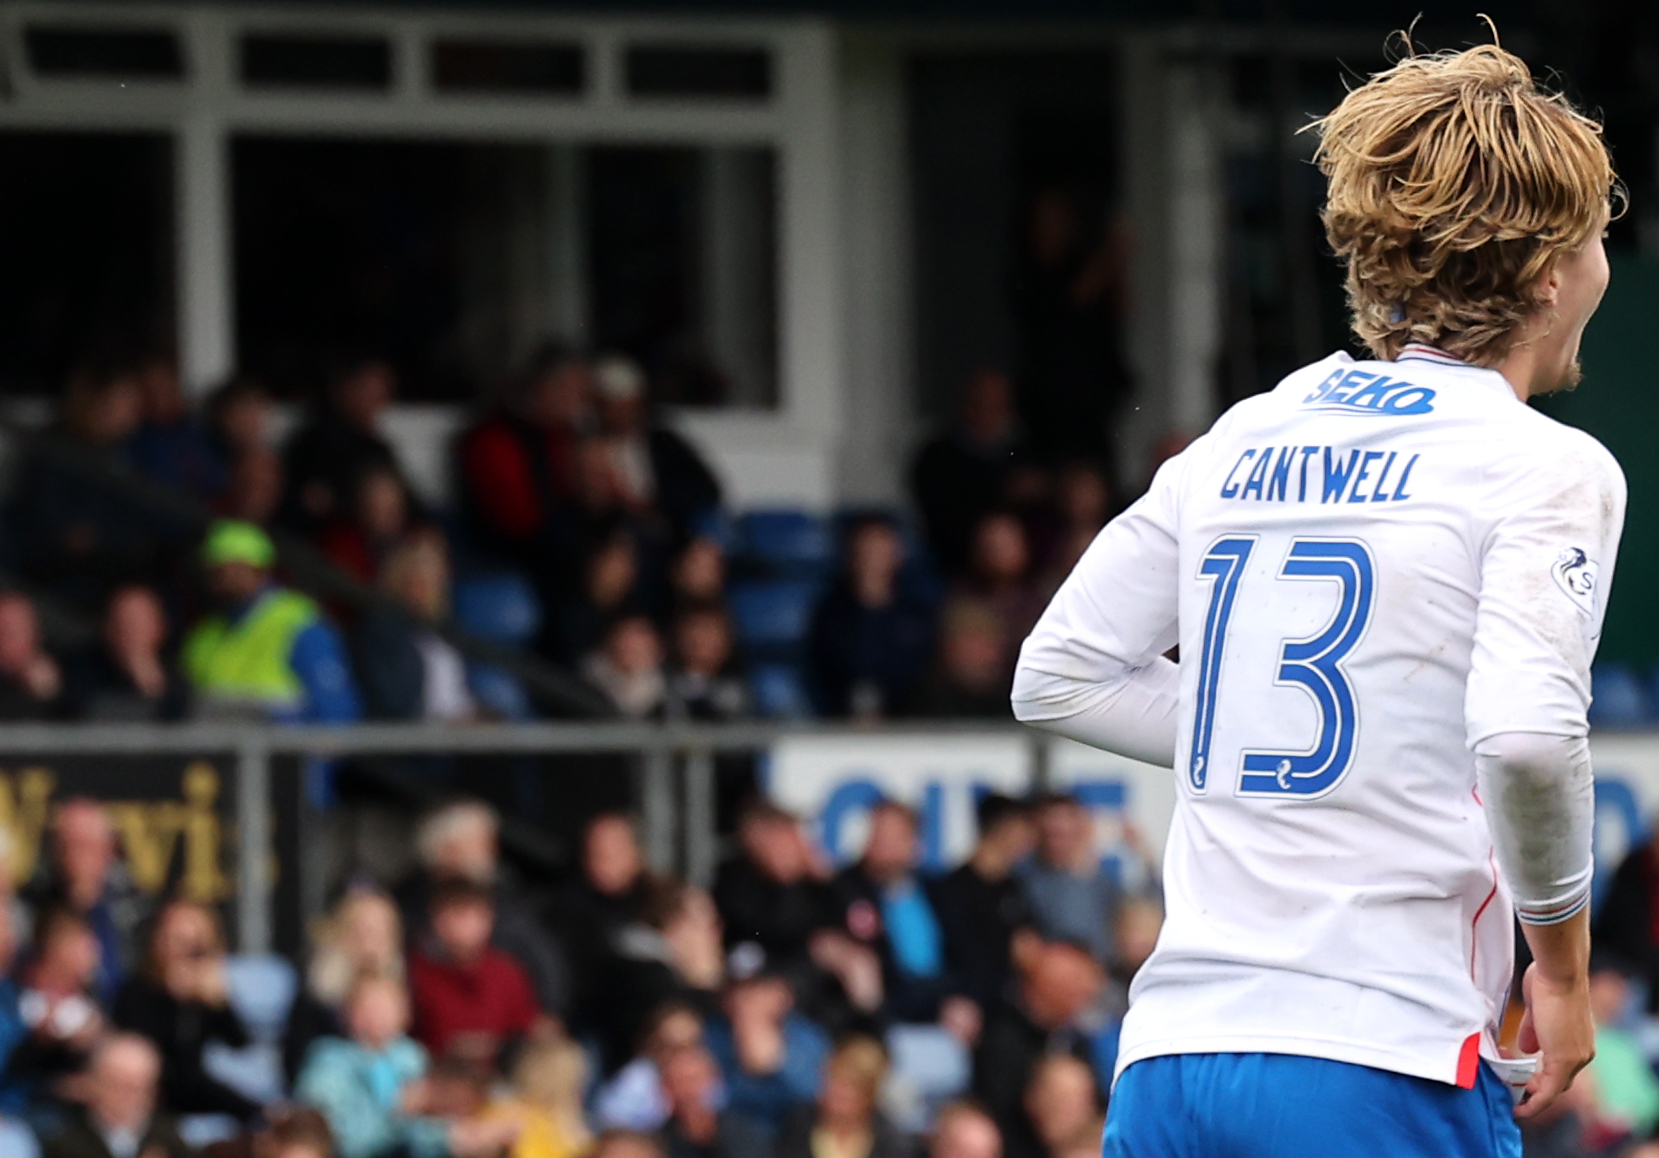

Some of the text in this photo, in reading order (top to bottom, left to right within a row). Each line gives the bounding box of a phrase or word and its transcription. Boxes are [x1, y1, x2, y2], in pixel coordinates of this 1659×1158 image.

[1301, 368, 1437, 416] SEKO
[1220, 446, 1421, 504] CANTWELL
[1190, 534, 1376, 798] 13
